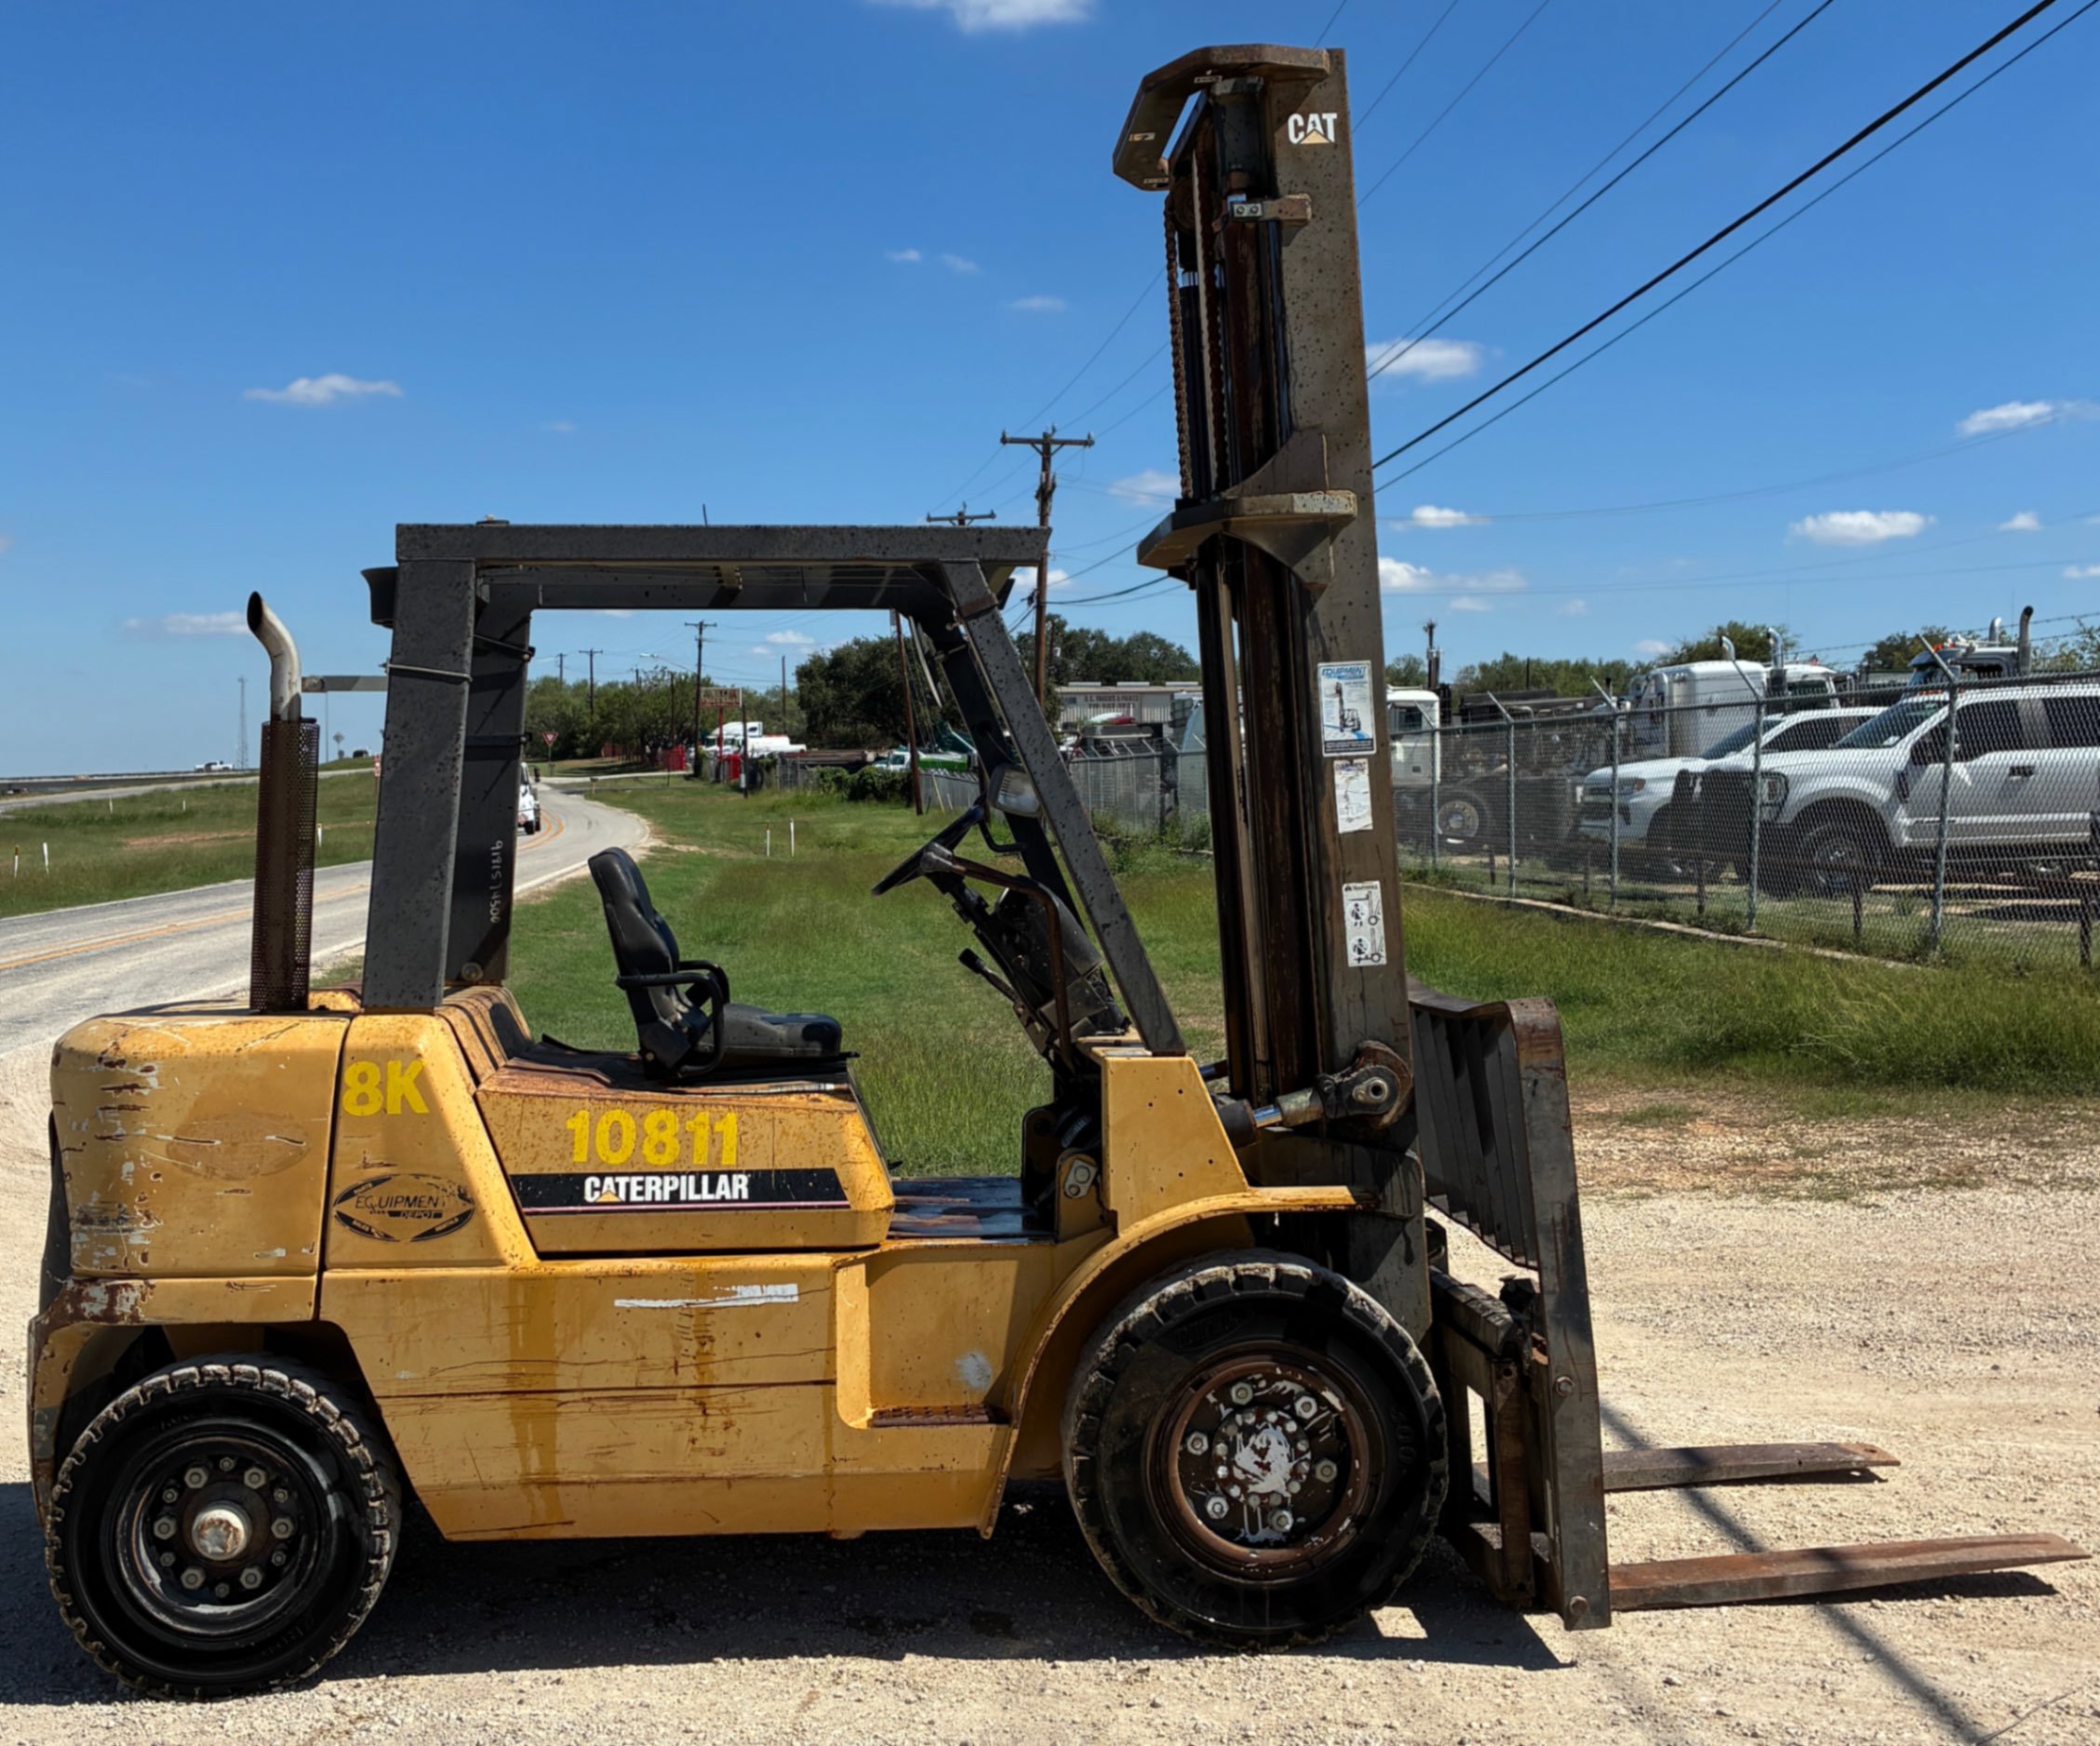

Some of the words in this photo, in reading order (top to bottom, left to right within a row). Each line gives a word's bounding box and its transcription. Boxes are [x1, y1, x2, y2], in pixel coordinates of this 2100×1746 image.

[1288, 113, 1337, 144] CAT
[341, 1060, 430, 1117] 8K
[566, 1108, 738, 1166] 10811
[584, 1174, 750, 1203] CATERPILLAR
